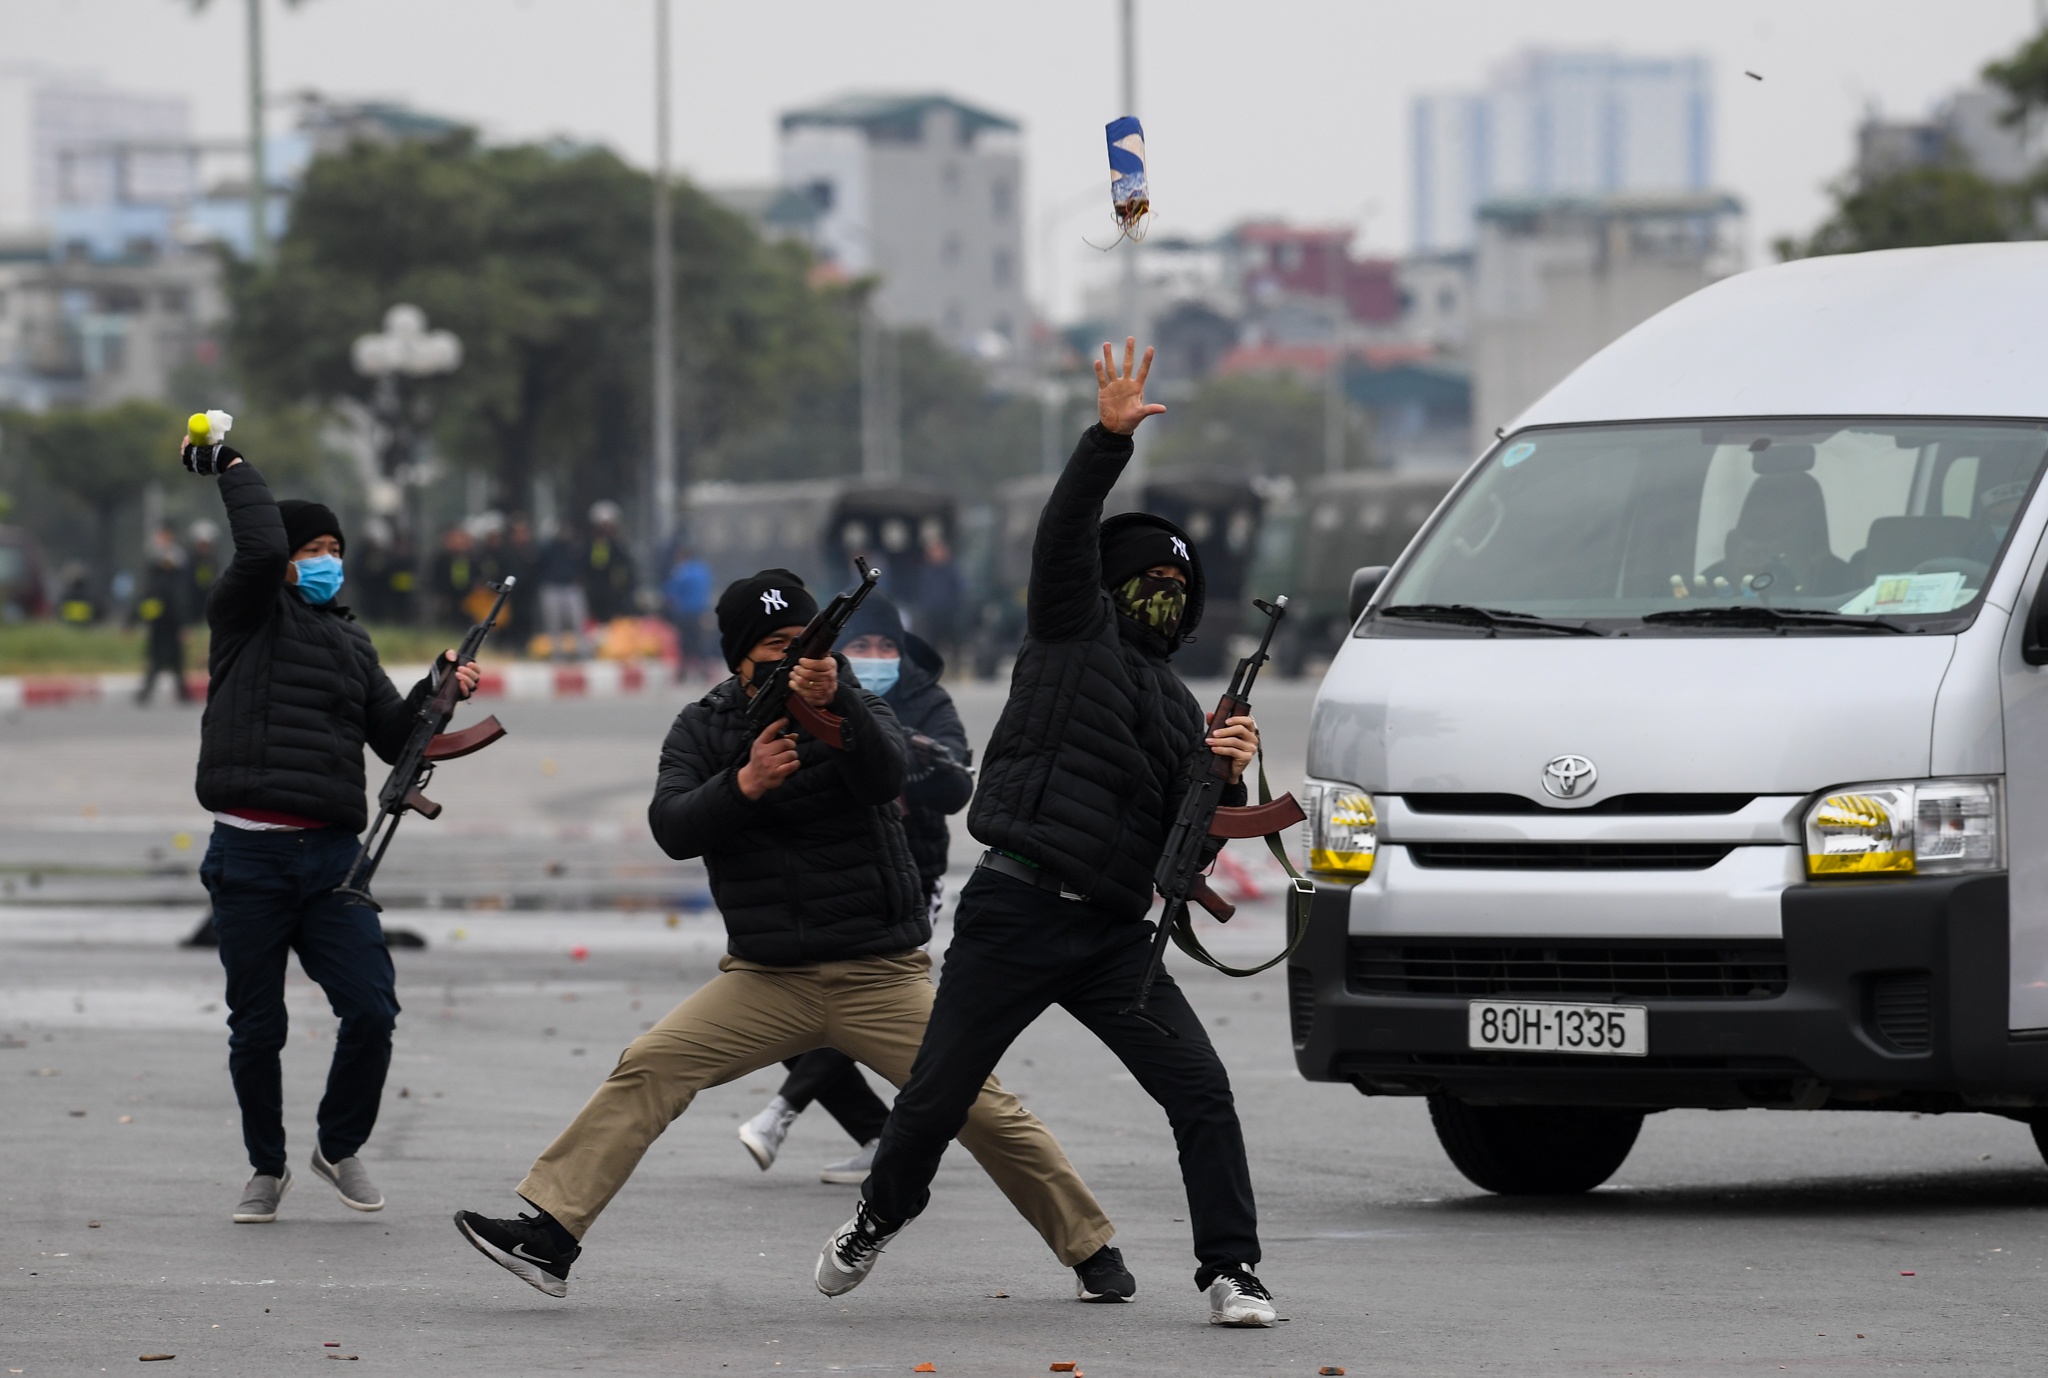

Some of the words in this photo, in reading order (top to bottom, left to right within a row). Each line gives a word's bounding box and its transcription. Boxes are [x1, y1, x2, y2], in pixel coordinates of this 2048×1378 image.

[1170, 536, 1190, 561] NY
[760, 588, 789, 615] NY
[1481, 1007, 1626, 1048] 80H-1335
